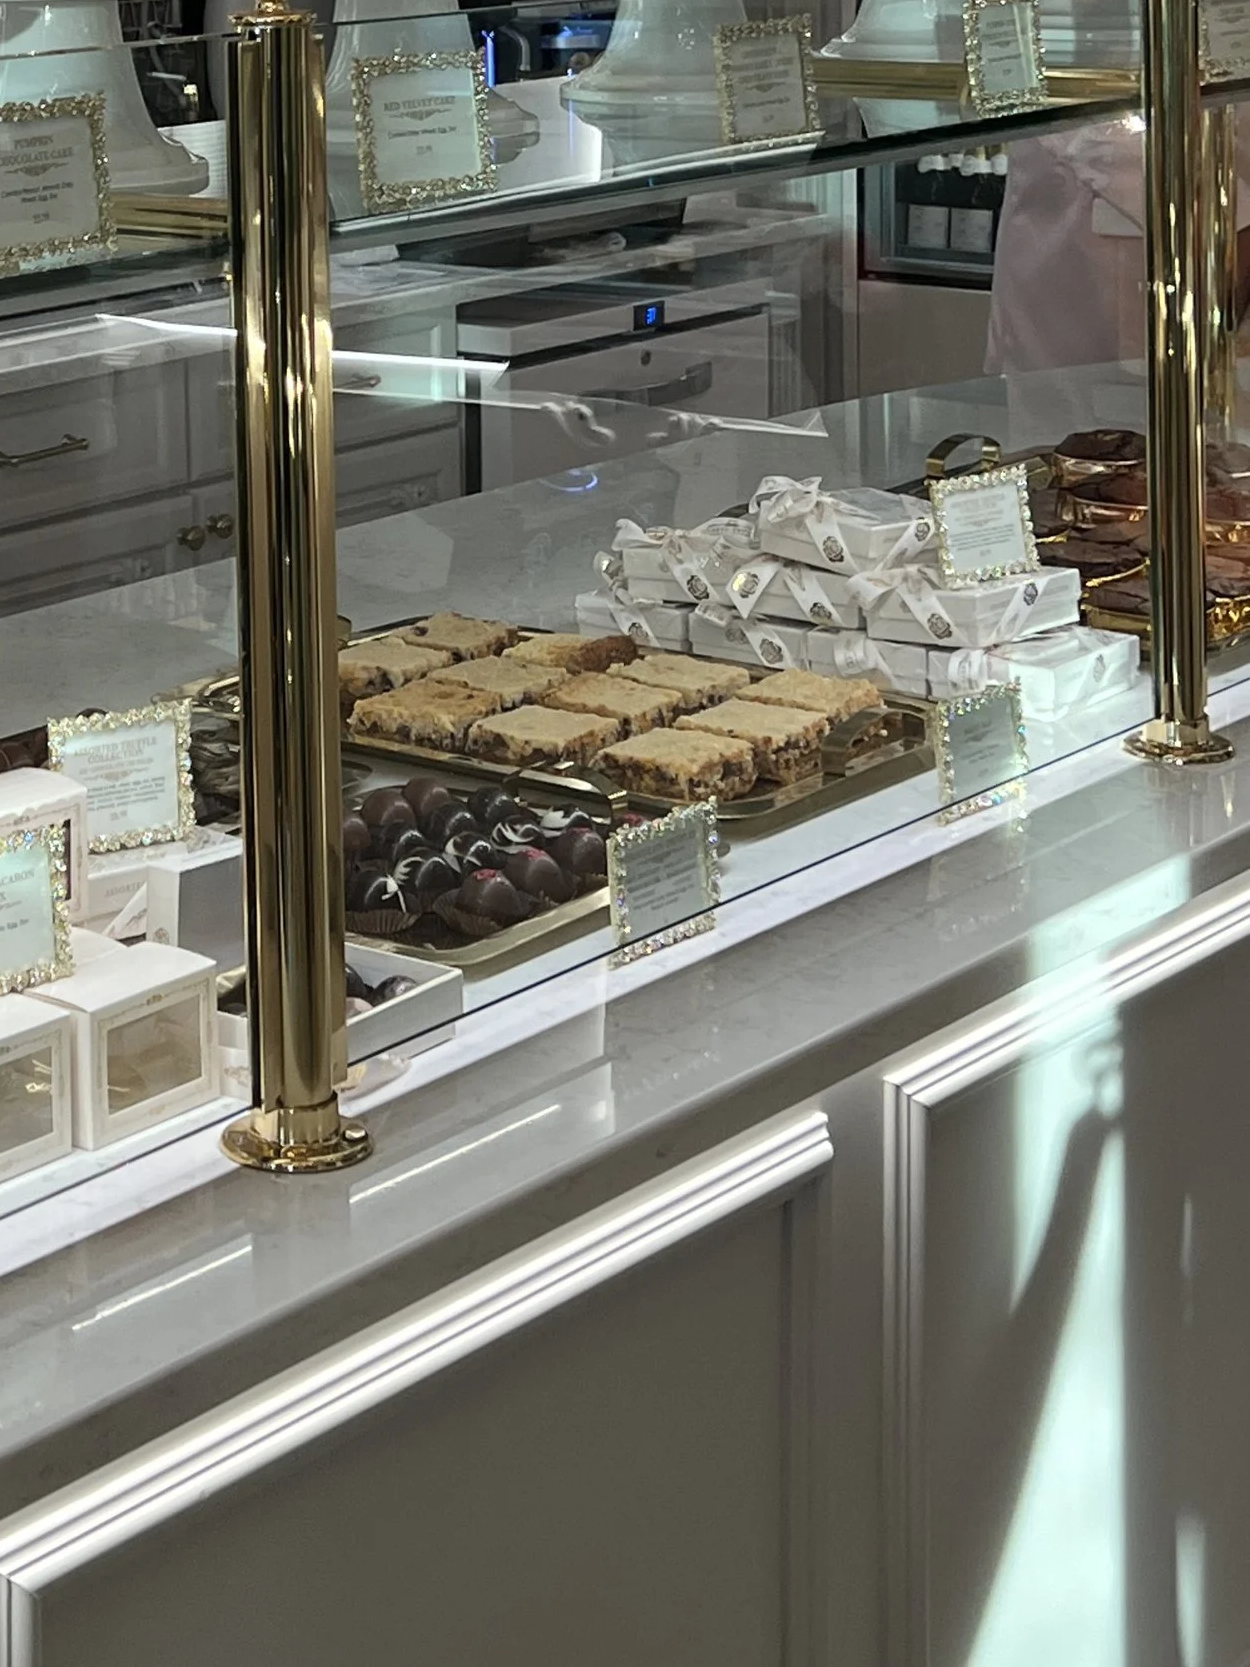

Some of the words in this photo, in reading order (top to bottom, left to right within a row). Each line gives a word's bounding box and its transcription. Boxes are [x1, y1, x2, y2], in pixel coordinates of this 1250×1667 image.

[384, 101, 400, 111] RED
[402, 97, 432, 109] VELVET
[434, 95, 455, 105] CAKE
[50, 146, 74, 159] CAKE
